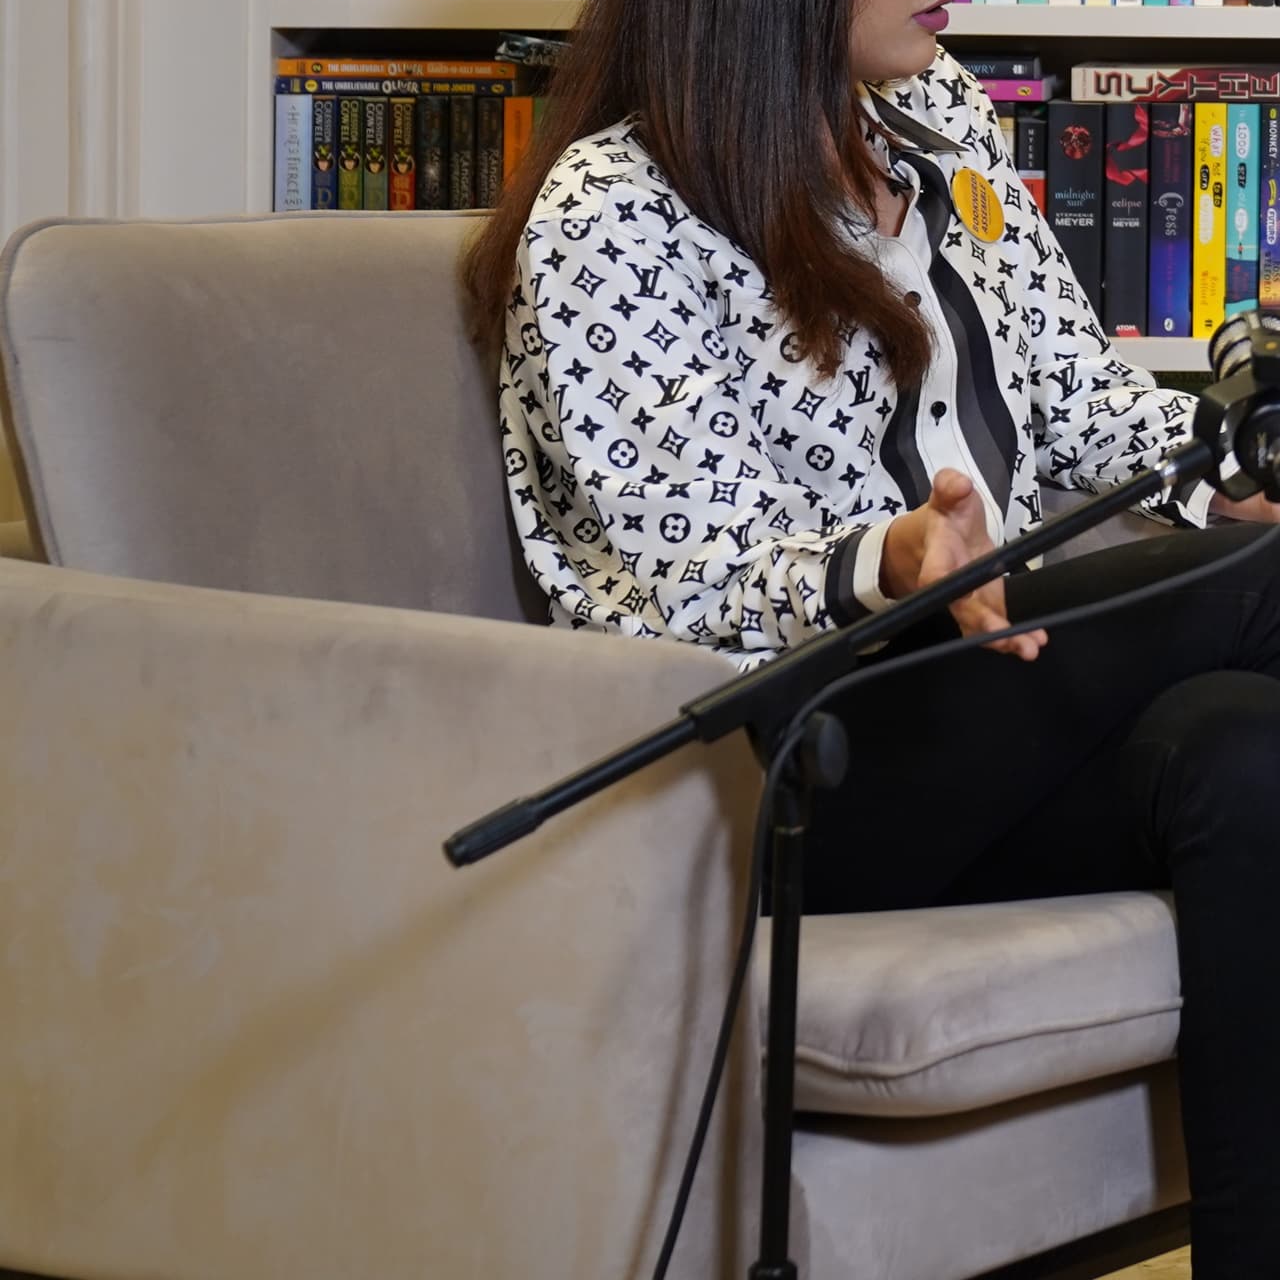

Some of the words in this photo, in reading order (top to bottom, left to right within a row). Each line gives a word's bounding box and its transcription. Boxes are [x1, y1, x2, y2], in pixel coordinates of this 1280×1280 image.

[1095, 70, 1280, 99] SCYTHE
[1269, 120, 1278, 159] MONKEY
[1055, 187, 1096, 201] midnight
[1055, 217, 1095, 227] MEYER
